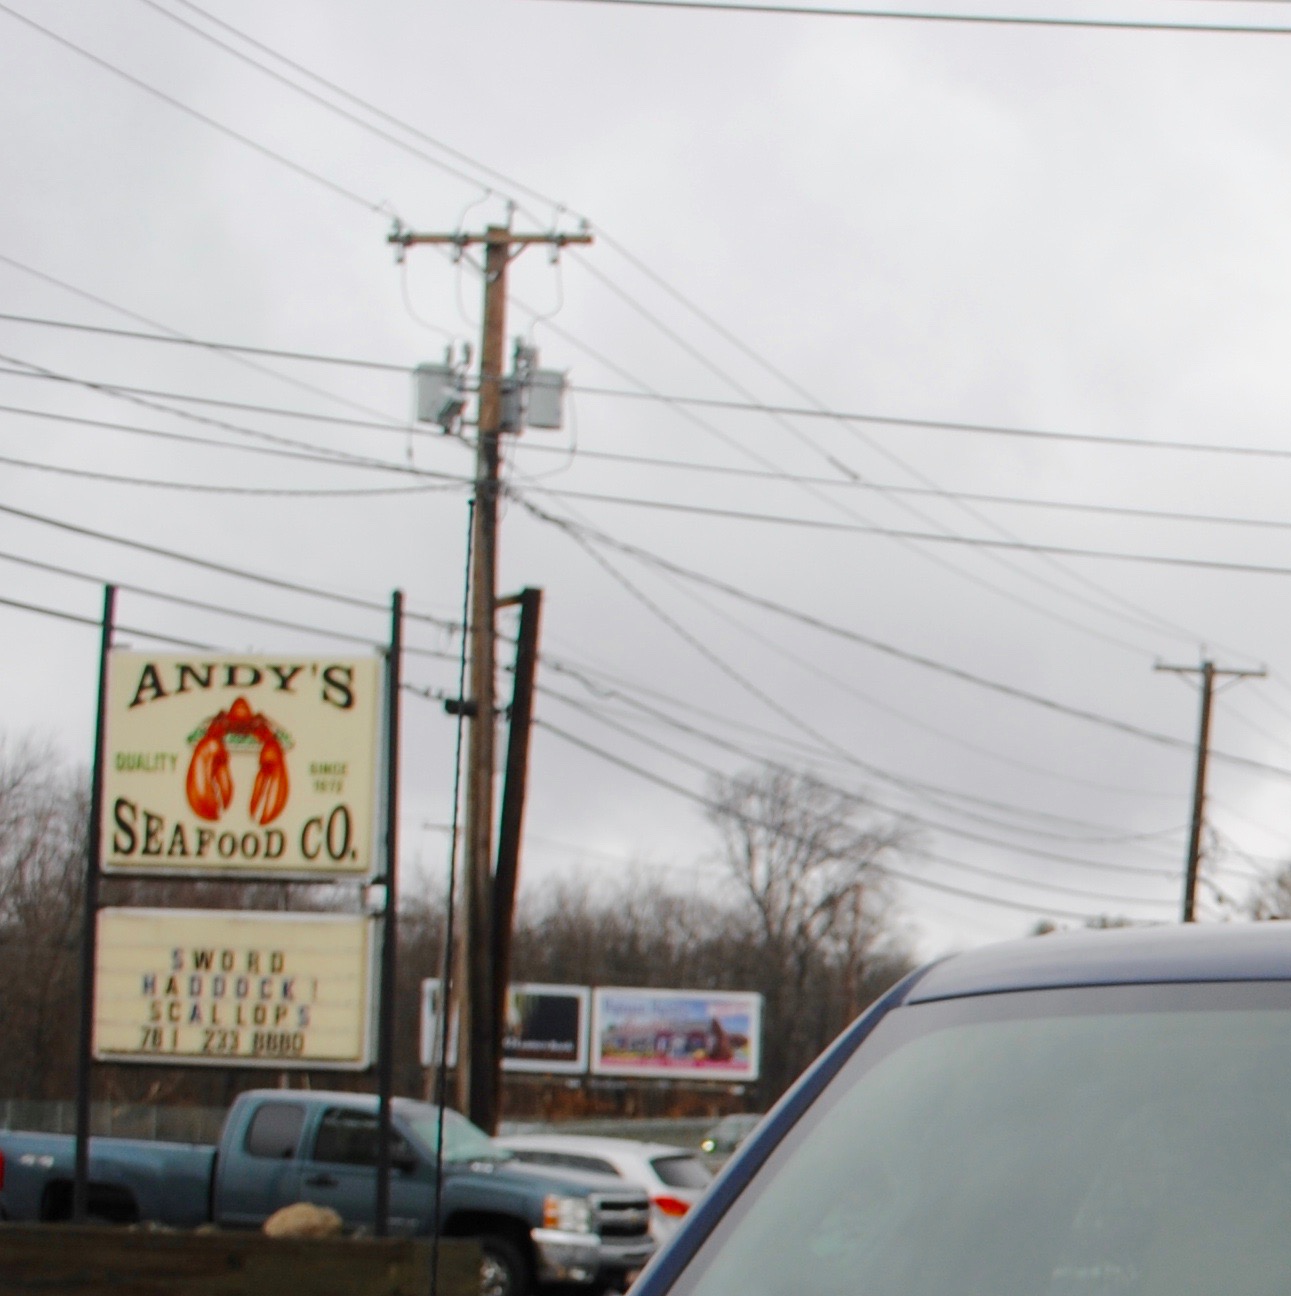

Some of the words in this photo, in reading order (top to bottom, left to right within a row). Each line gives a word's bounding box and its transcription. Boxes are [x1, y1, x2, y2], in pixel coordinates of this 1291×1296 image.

[129, 663, 356, 710] ANDY'S
[115, 752, 178, 772] QUALITY
[113, 797, 286, 859] SEAFOOD
[301, 805, 357, 861] CO.
[171, 950, 286, 972] SWORD
[150, 1002, 310, 1026] SCALLOPS
[142, 1029, 179, 1049] 781
[203, 1031, 240, 1052] 233
